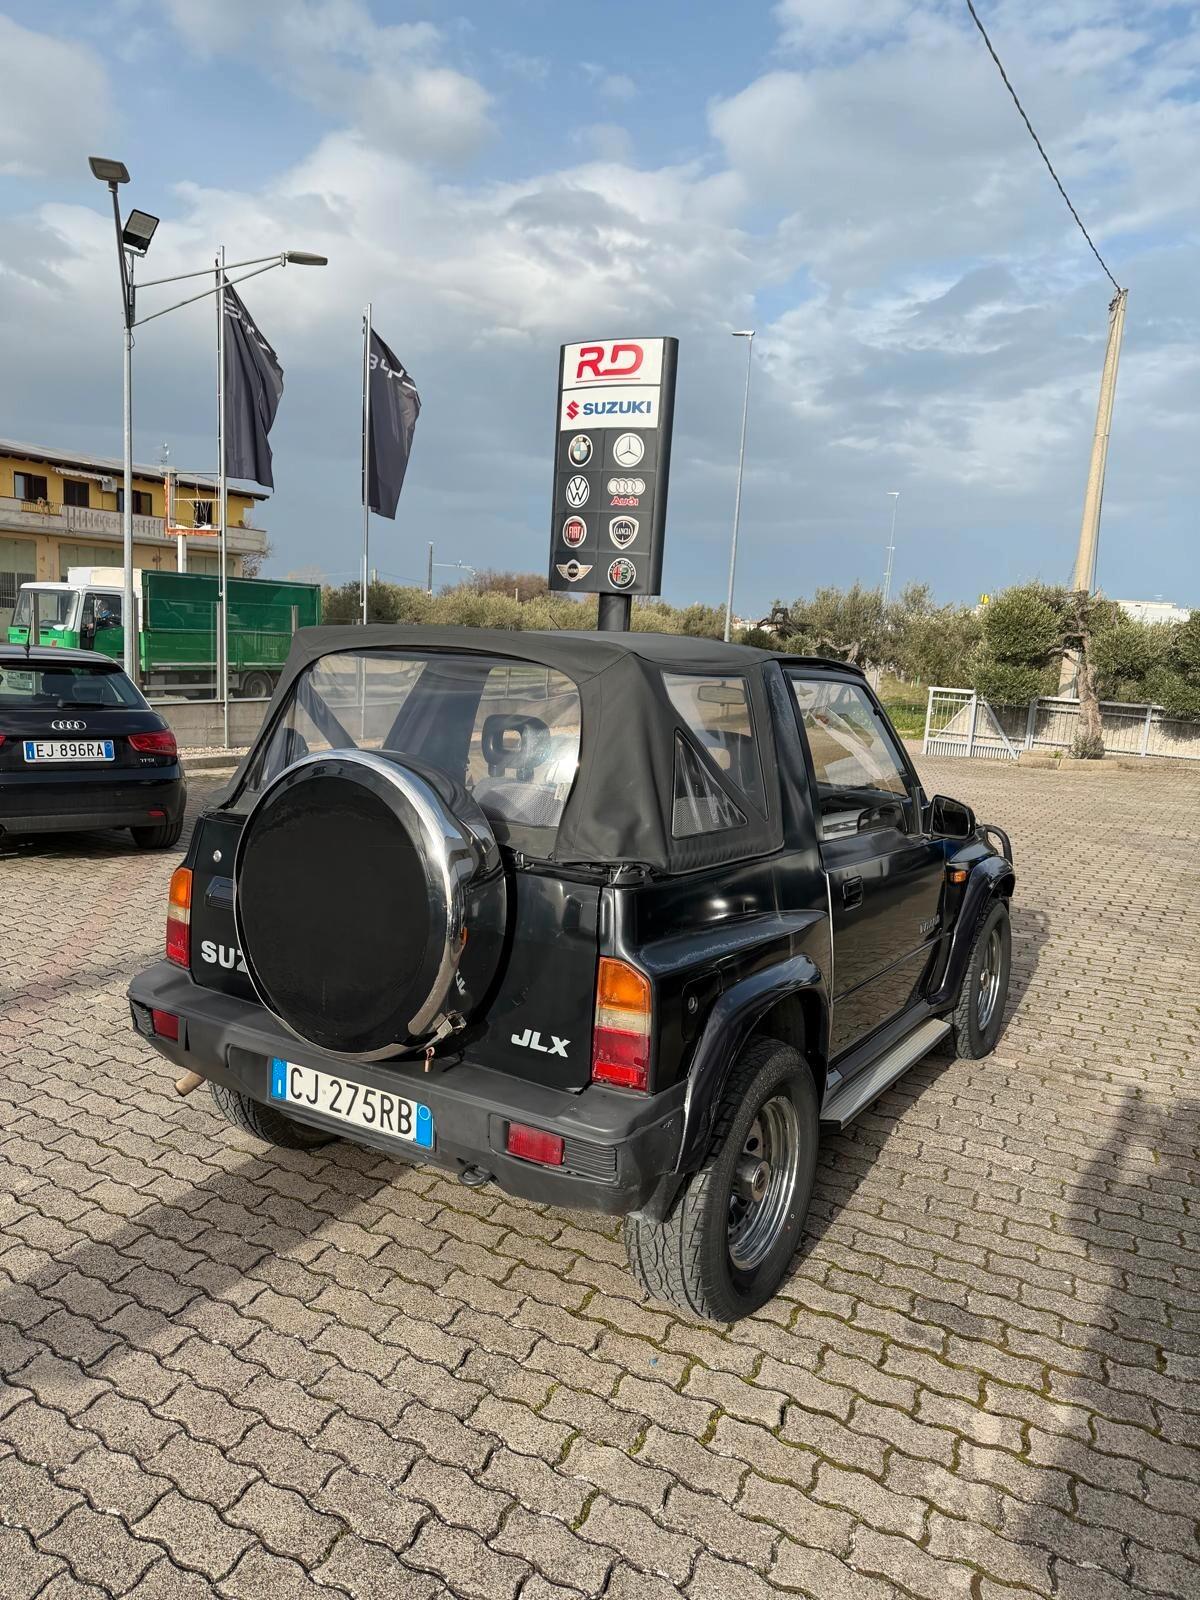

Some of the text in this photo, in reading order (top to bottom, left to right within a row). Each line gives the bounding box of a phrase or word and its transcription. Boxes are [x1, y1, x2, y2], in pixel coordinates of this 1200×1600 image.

[577, 344, 643, 378] RD
[583, 401, 651, 415] SUZUKI
[568, 526, 581, 539] FIAT
[511, 1028, 571, 1058] JLX
